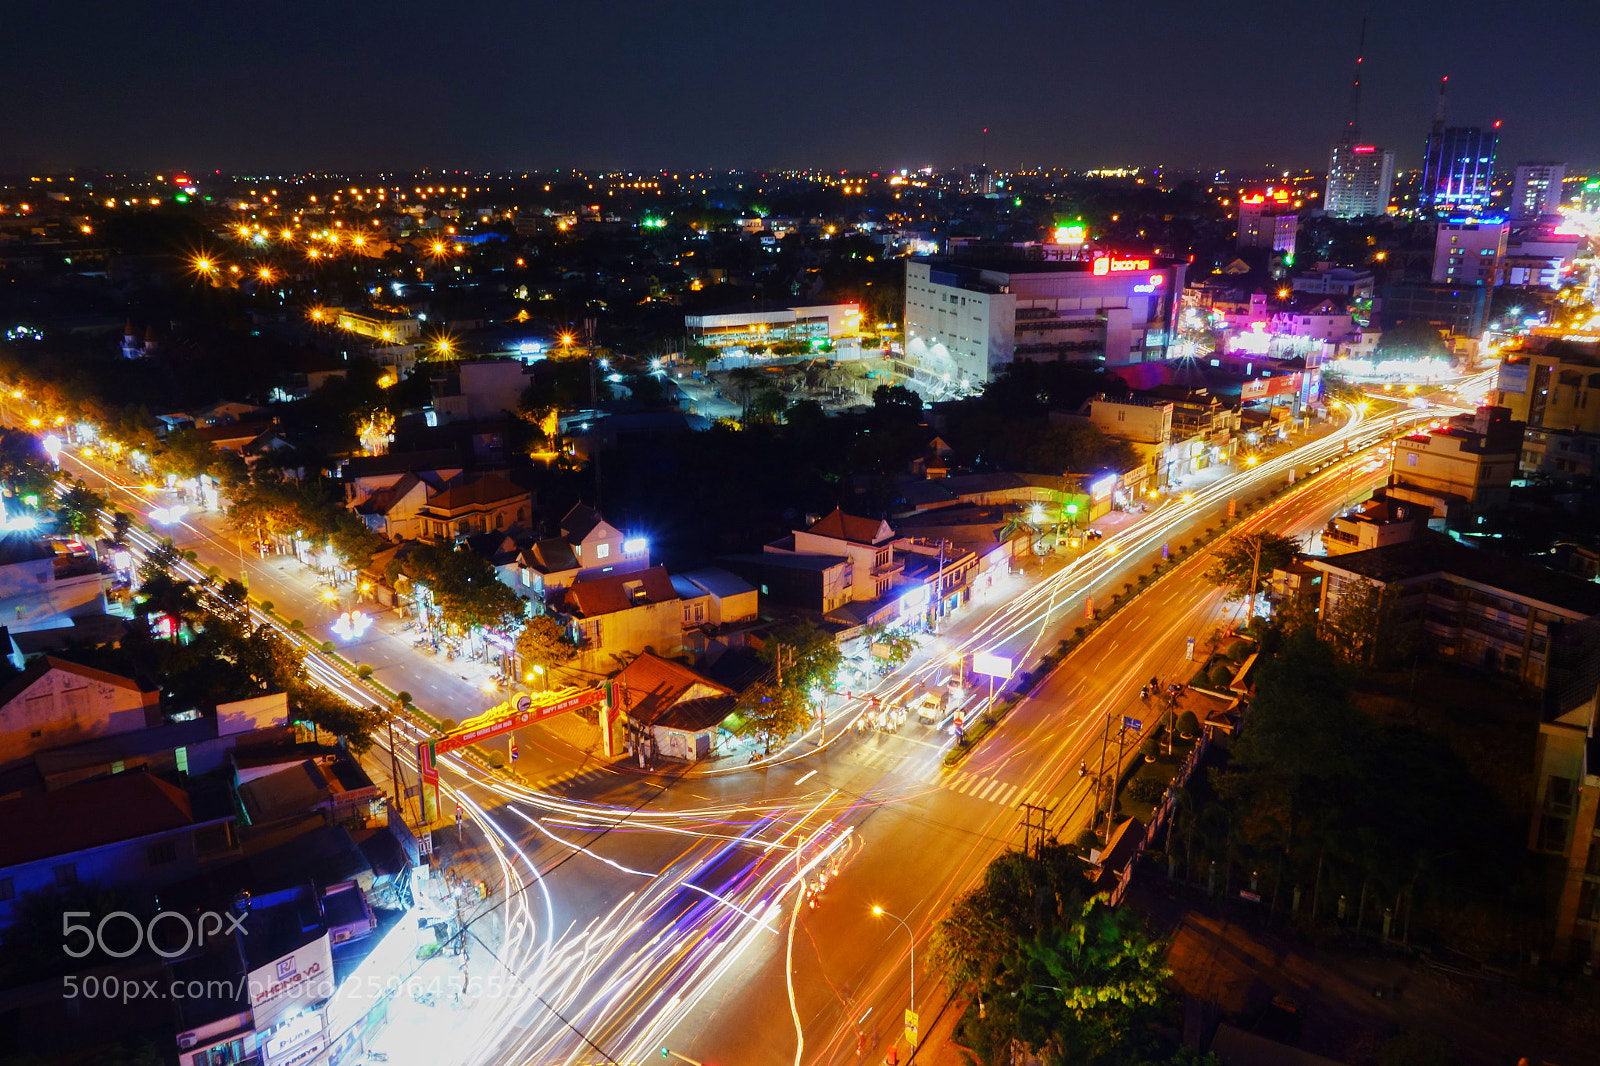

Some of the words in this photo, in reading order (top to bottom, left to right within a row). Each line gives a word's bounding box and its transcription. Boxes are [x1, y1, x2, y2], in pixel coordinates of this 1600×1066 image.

[1110, 257, 1150, 272] biconsi
[542, 705, 557, 715] HAPPY
[557, 701, 568, 710] NEW
[568, 698, 579, 706] YEAR
[256, 973, 302, 1002] PHONG
